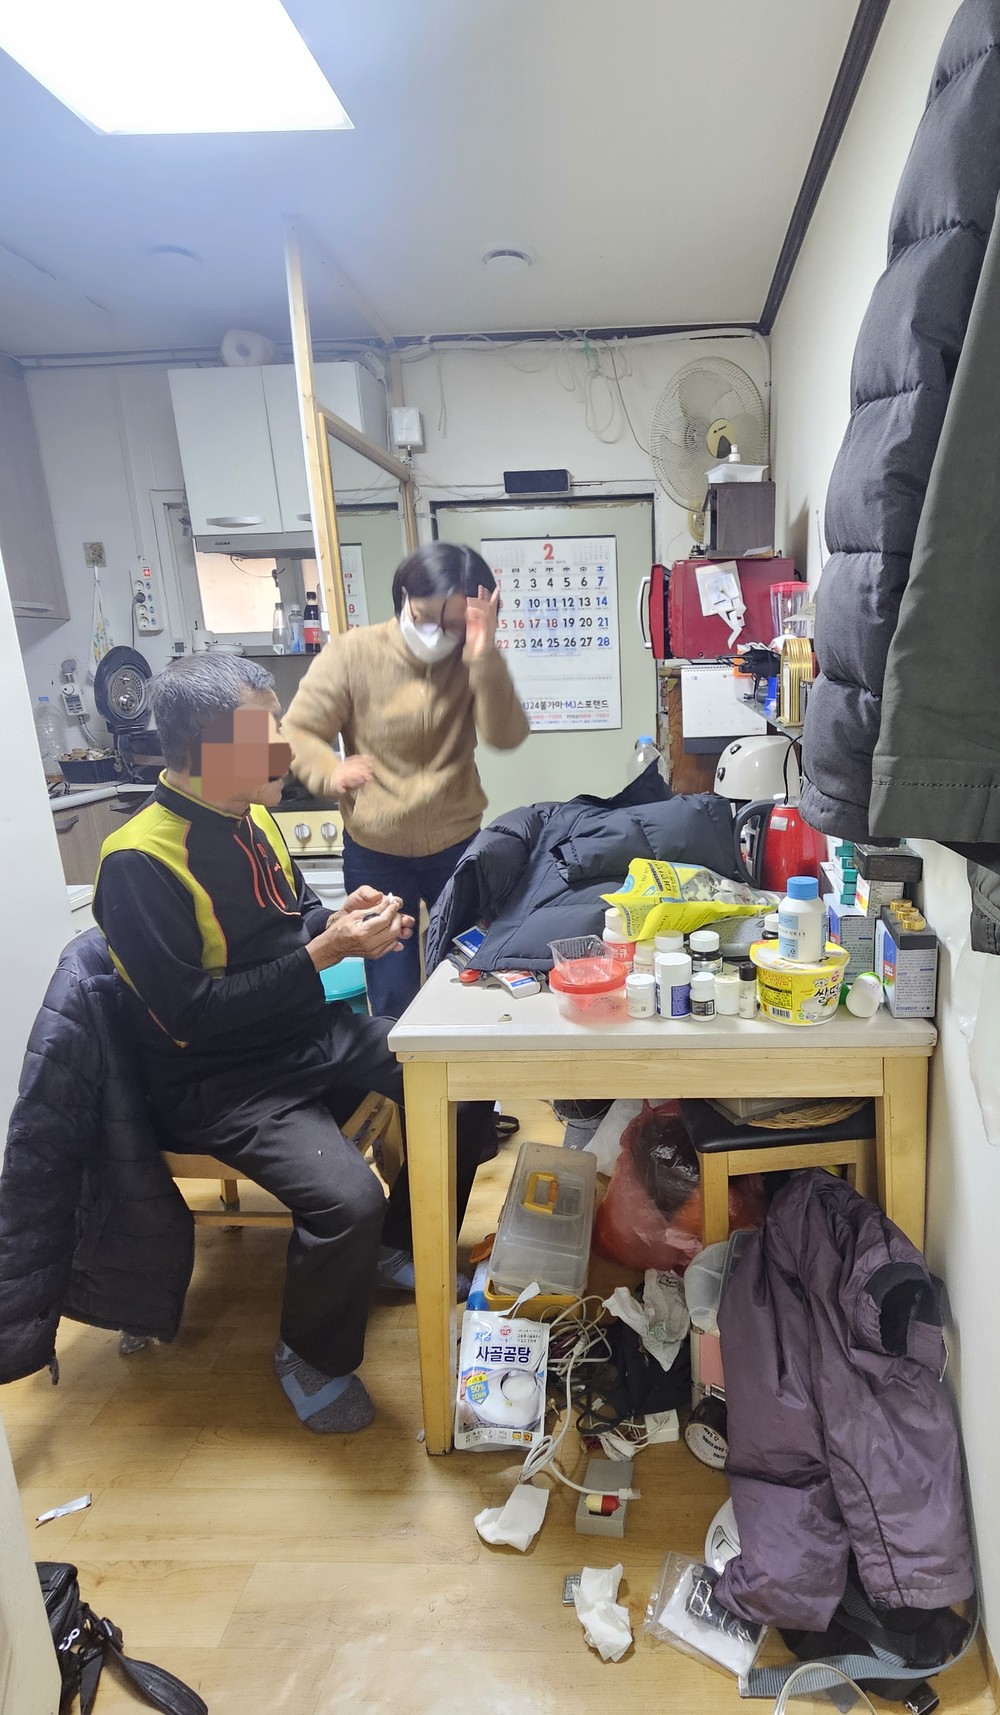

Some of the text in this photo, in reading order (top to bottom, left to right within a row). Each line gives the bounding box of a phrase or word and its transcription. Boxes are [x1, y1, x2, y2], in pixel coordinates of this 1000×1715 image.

[543, 543, 555, 560] 2
[513, 578, 520, 589] 2
[530, 578, 537, 588] 3
[547, 577, 554, 588] 4
[564, 577, 571, 587] 5
[581, 576, 588, 587] 6
[597, 576, 604, 587] 7
[514, 598, 521, 608] 9
[529, 598, 540, 608] 10
[546, 598, 557, 608] 11
[562, 597, 575, 607] 12
[579, 596, 591, 607] 13
[596, 596, 608, 606] 14
[513, 619, 525, 629] 16
[529, 618, 541, 629] 17
[546, 618, 558, 628] 18
[563, 617, 575, 628] 19
[580, 617, 593, 627] 20
[597, 616, 609, 627] 21
[497, 636, 610, 650] 22 23 24 25 26 27 28
[475, 1346, 531, 1363] 사골곰탕
